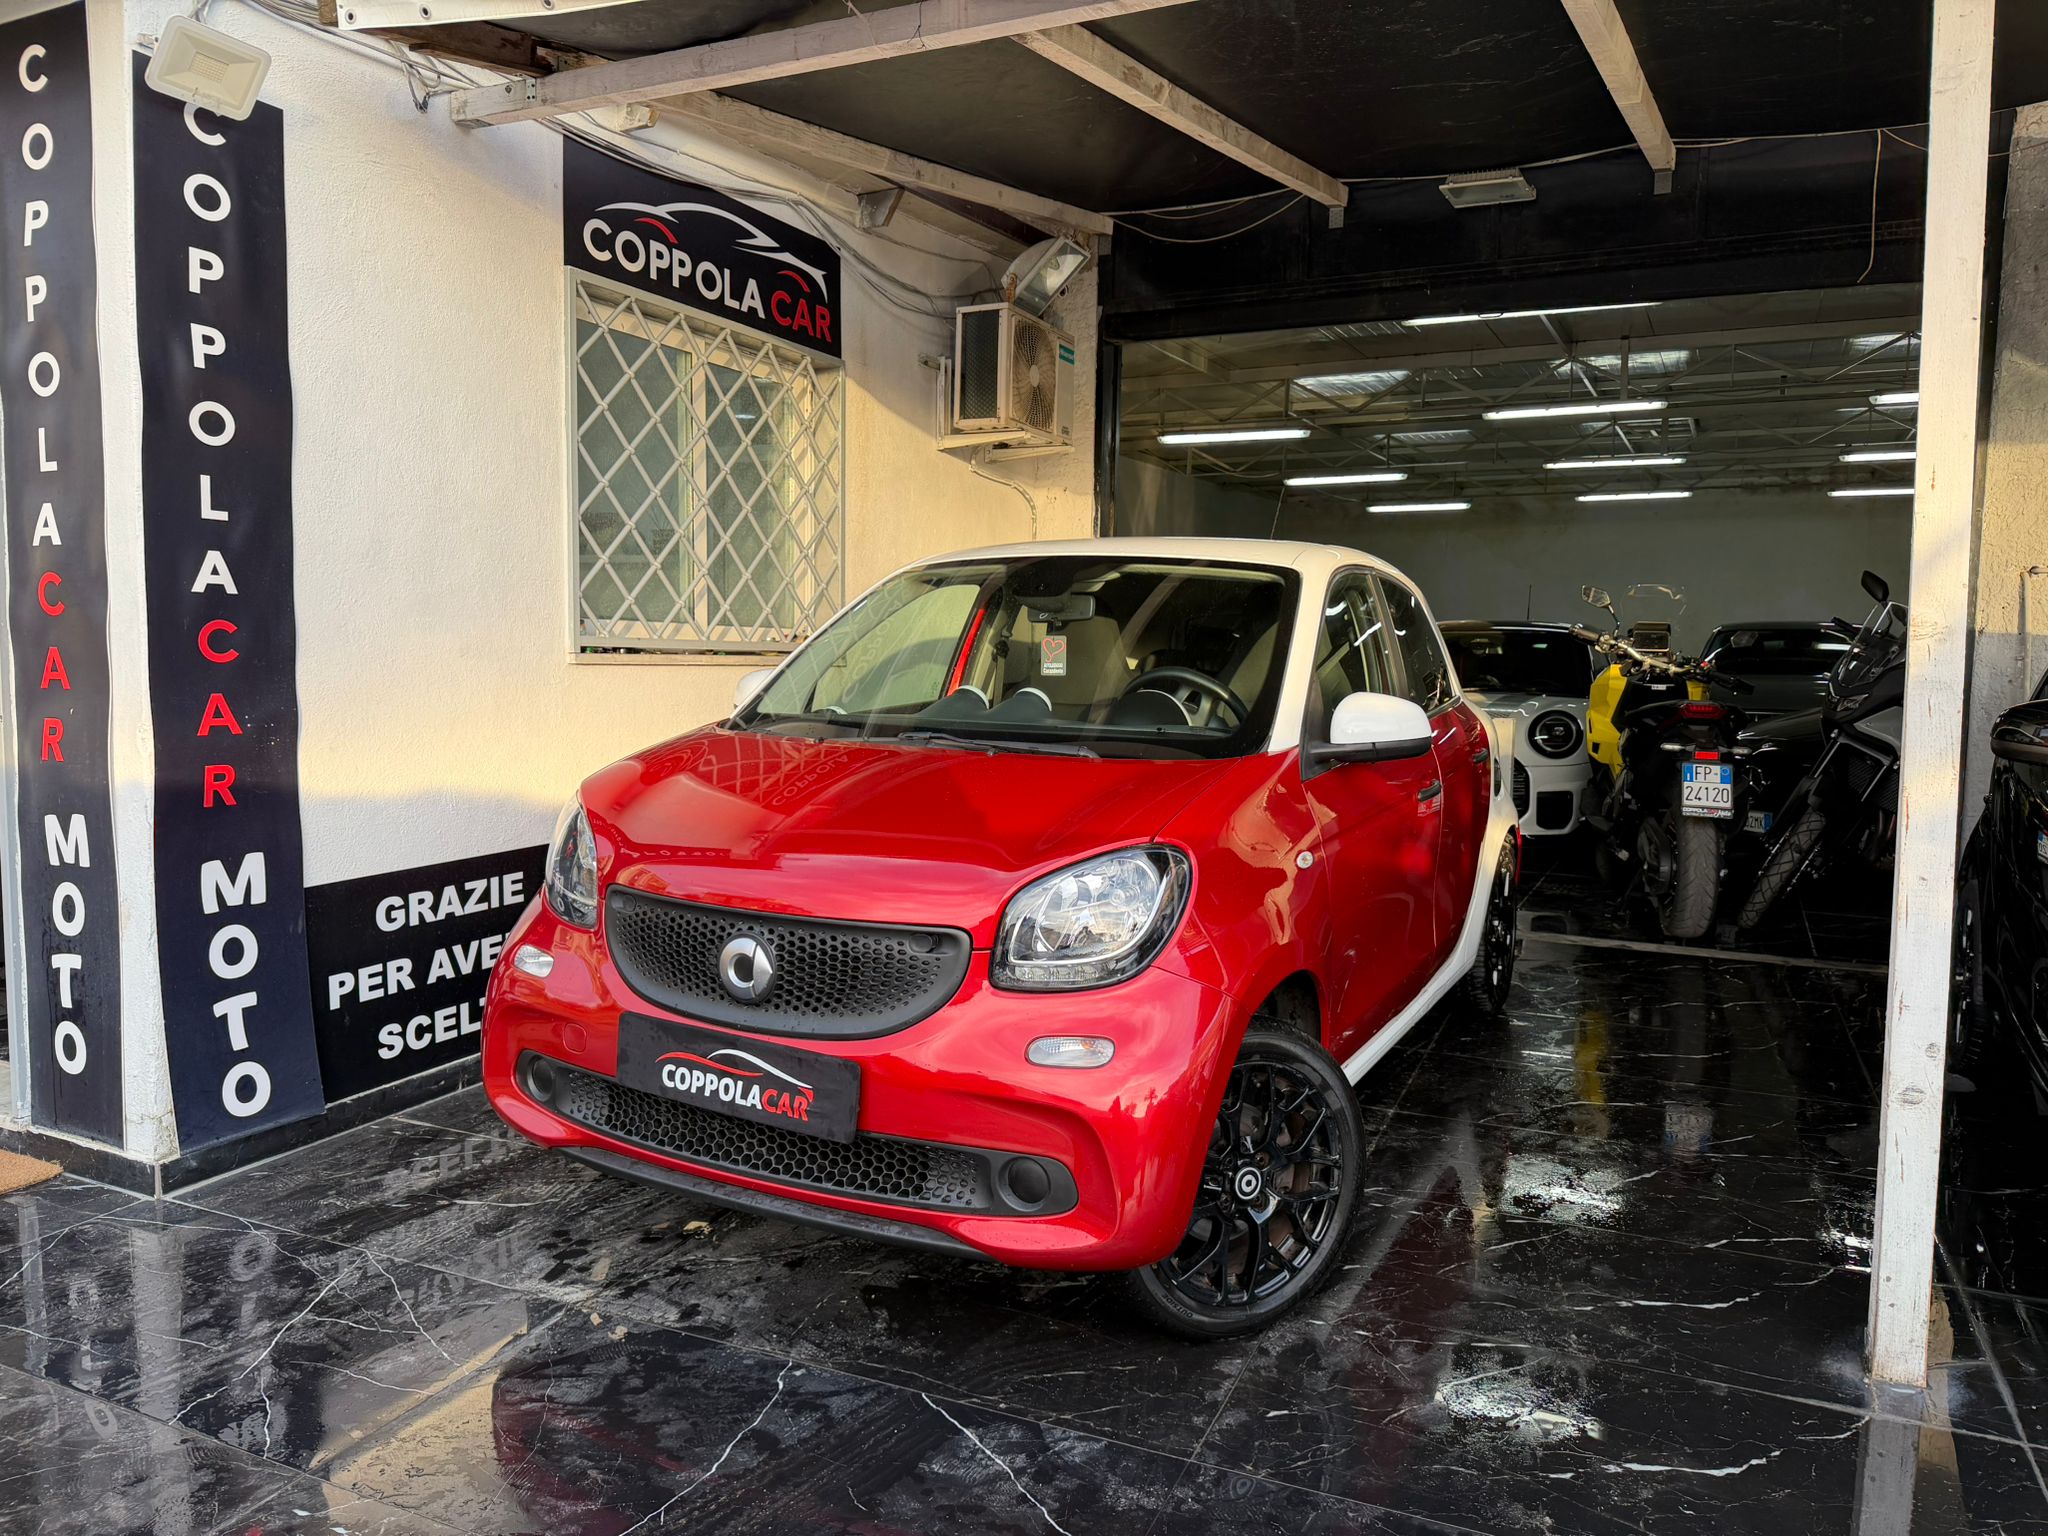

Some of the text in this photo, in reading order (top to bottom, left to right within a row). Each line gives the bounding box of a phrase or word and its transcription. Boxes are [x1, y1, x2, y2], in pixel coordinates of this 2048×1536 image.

[1685, 786, 1730, 804] 24120
[1694, 766, 1712, 781] FP
[375, 871, 525, 932] GRAZIE
[44, 814, 91, 1075] MOTO
[328, 932, 511, 1011] PER AVE
[200, 852, 272, 1118] MOTO
